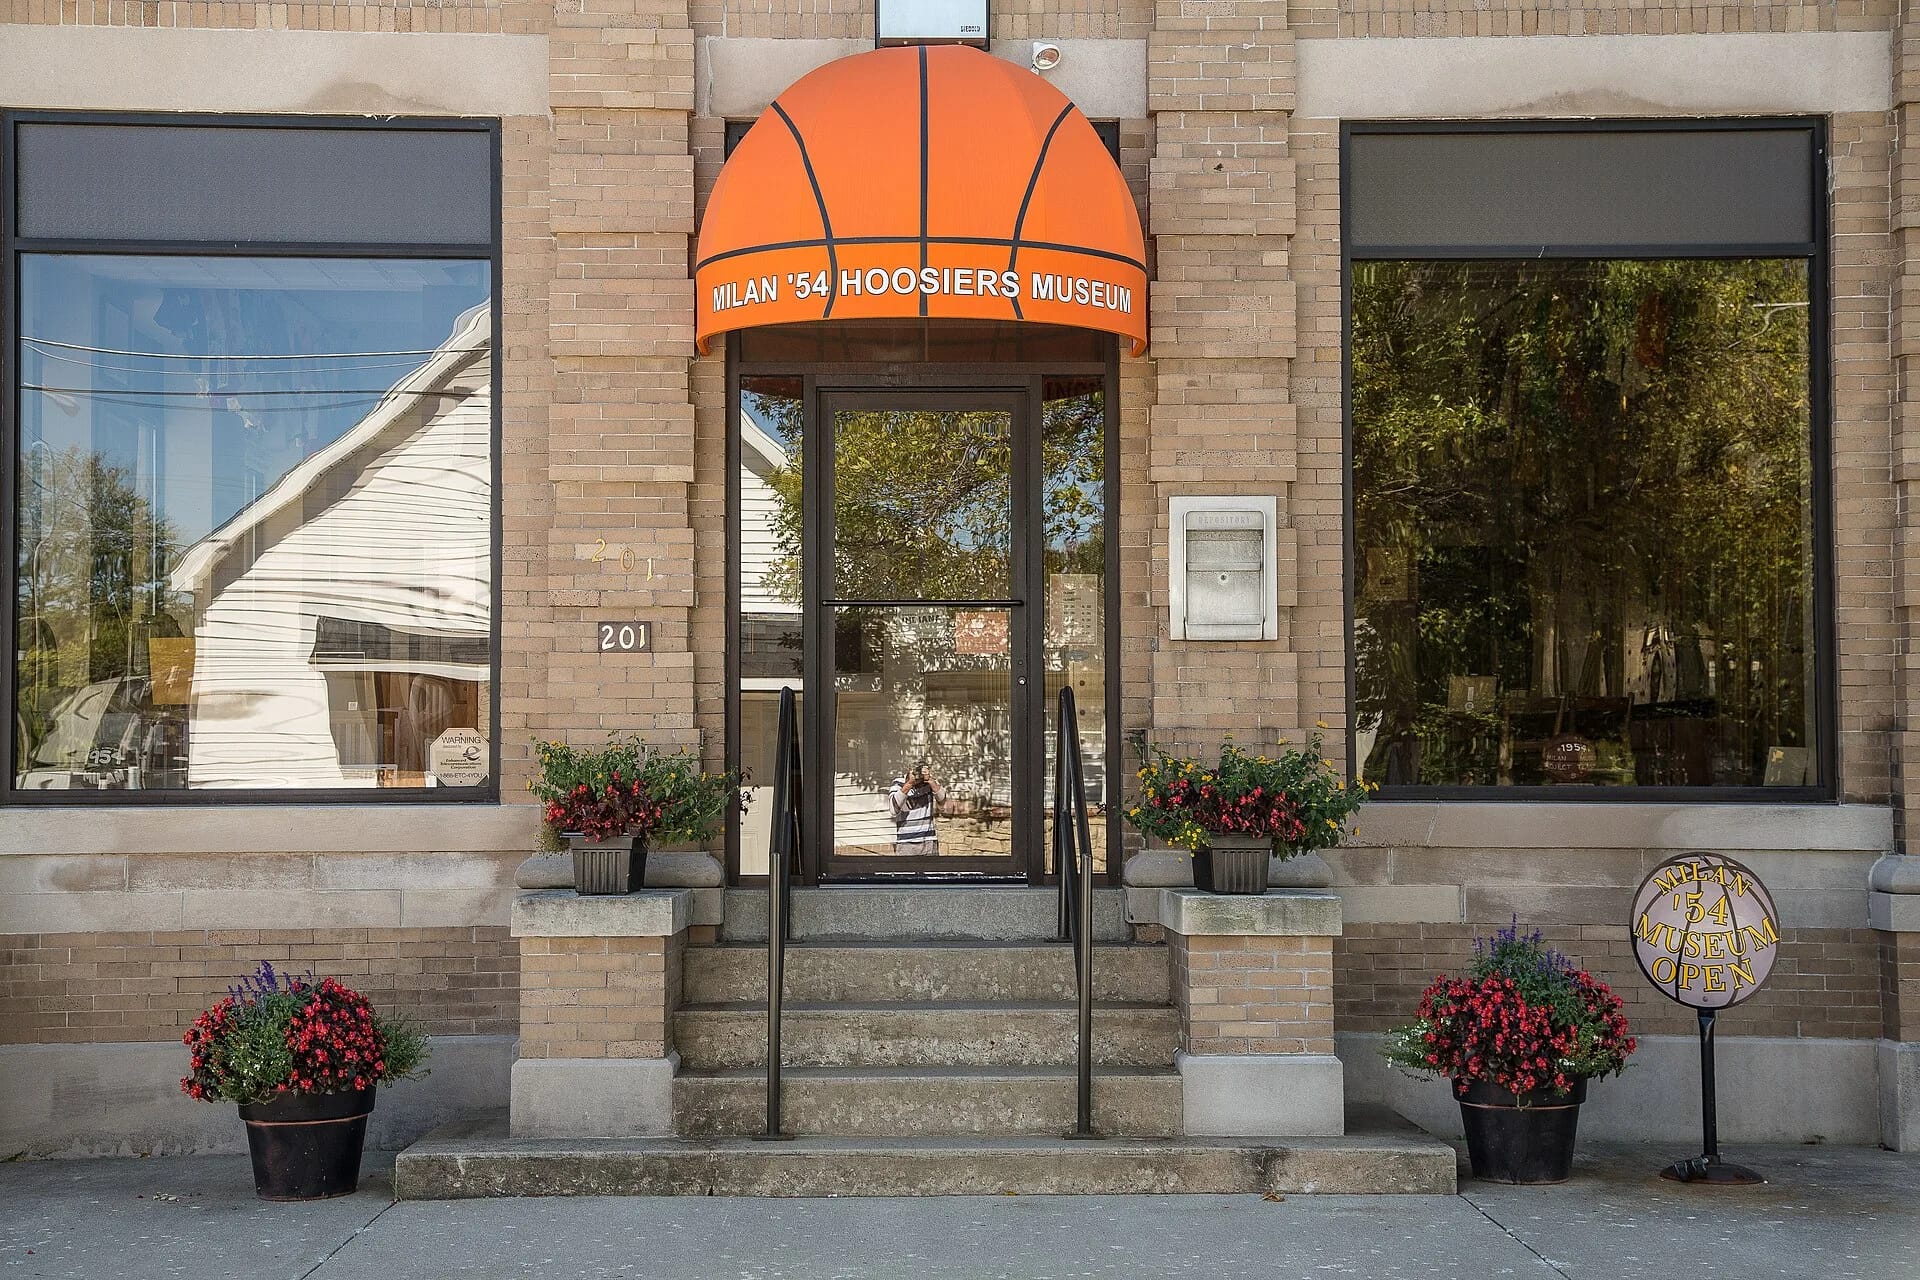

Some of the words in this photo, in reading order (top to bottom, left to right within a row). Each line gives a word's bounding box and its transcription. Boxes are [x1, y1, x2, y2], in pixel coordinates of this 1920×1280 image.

[712, 273, 778, 313] MILAN
[787, 269, 830, 299] '54
[840, 266, 1021, 299] HOOSIERS
[1032, 272, 1132, 314] MUSEUM
[591, 538, 653, 582] 201
[601, 624, 646, 651] 201
[442, 736, 481, 744] WARNING
[1653, 862, 1752, 897] MILAN
[1673, 891, 1729, 926] '54
[1633, 913, 1781, 960] MUSEUM
[1652, 956, 1757, 992] OPEN
